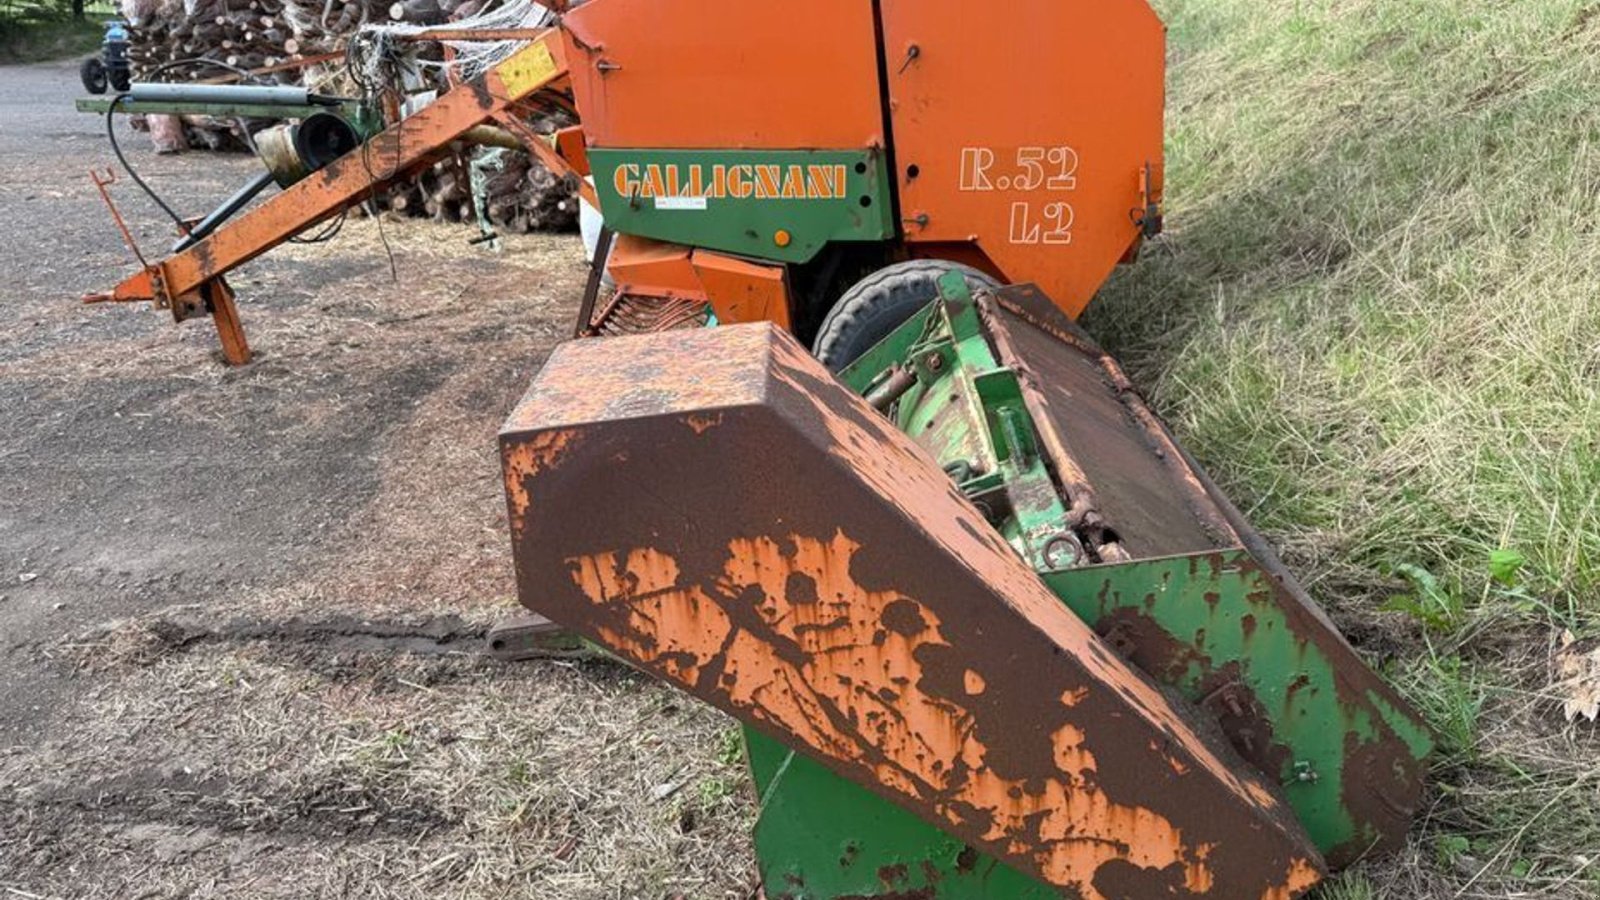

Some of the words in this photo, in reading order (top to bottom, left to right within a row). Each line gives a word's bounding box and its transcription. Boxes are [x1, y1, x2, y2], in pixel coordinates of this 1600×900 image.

[613, 163, 847, 199] GALLIGNANI
[959, 146, 1079, 191] R.52
[1009, 202, 1074, 244] L2
